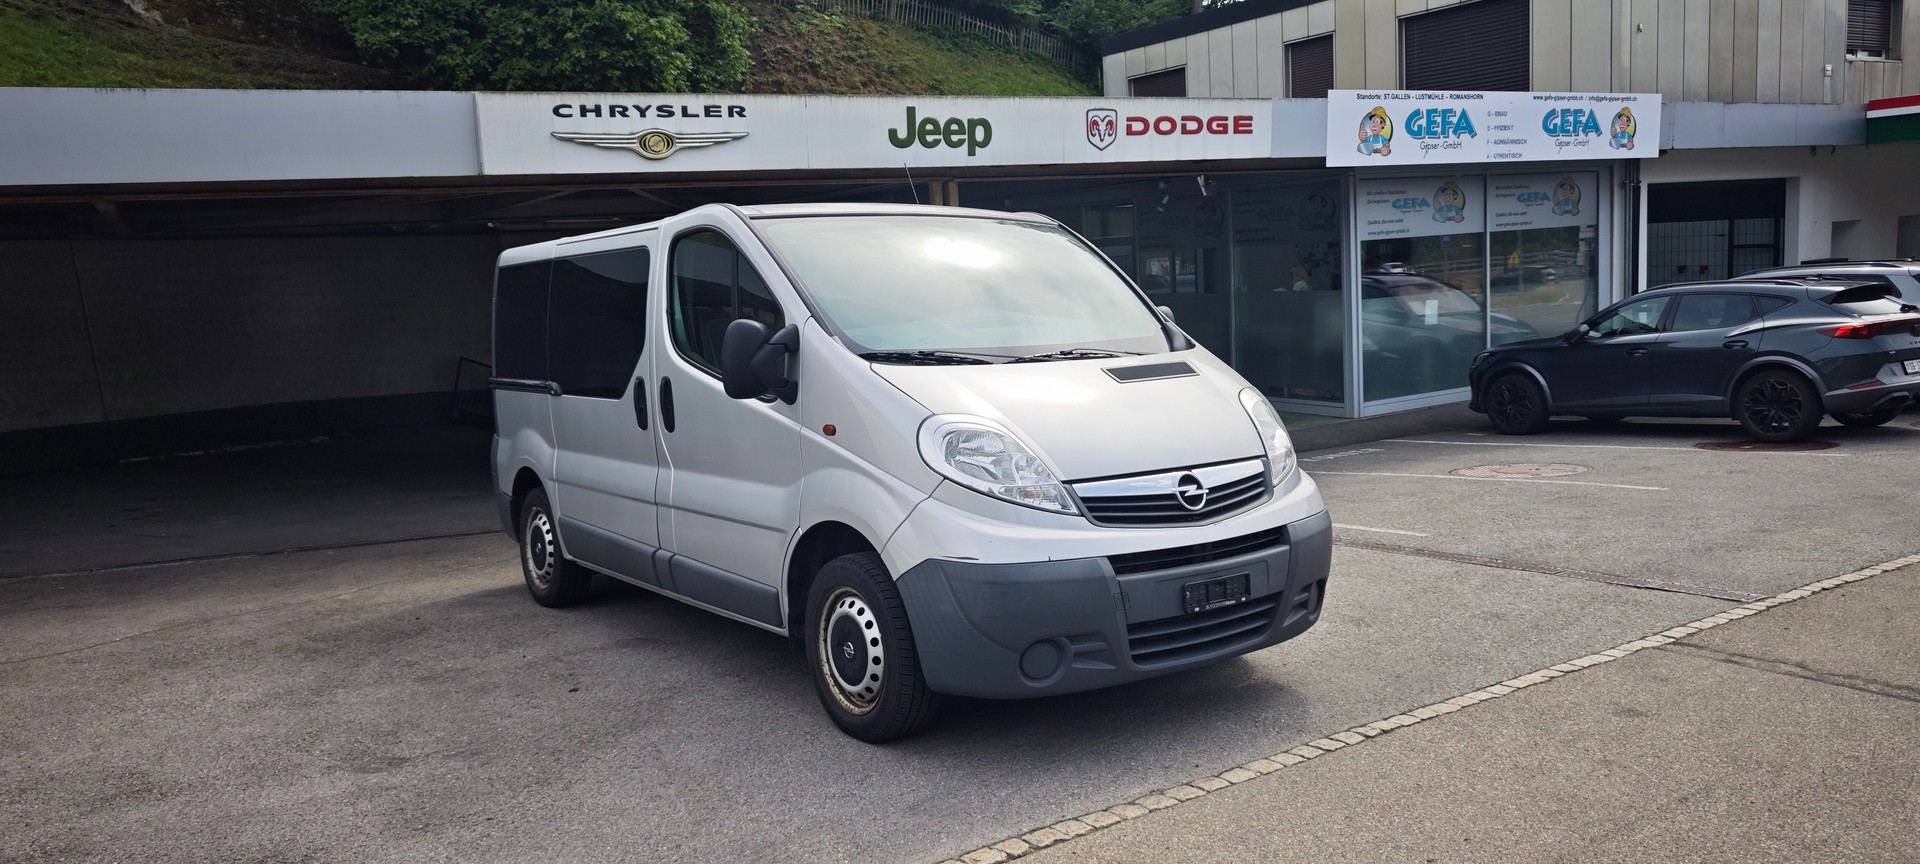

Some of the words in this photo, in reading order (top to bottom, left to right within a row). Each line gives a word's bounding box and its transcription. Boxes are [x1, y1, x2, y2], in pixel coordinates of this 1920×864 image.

[552, 103, 747, 118] CHRYSLER
[888, 106, 992, 156] Jeep
[1126, 116, 1253, 135] DODGE
[1404, 107, 1477, 139] GEFA
[1542, 108, 1602, 137] GEFA
[1392, 197, 1431, 210] GEFA
[1517, 191, 1551, 203] GEFA
